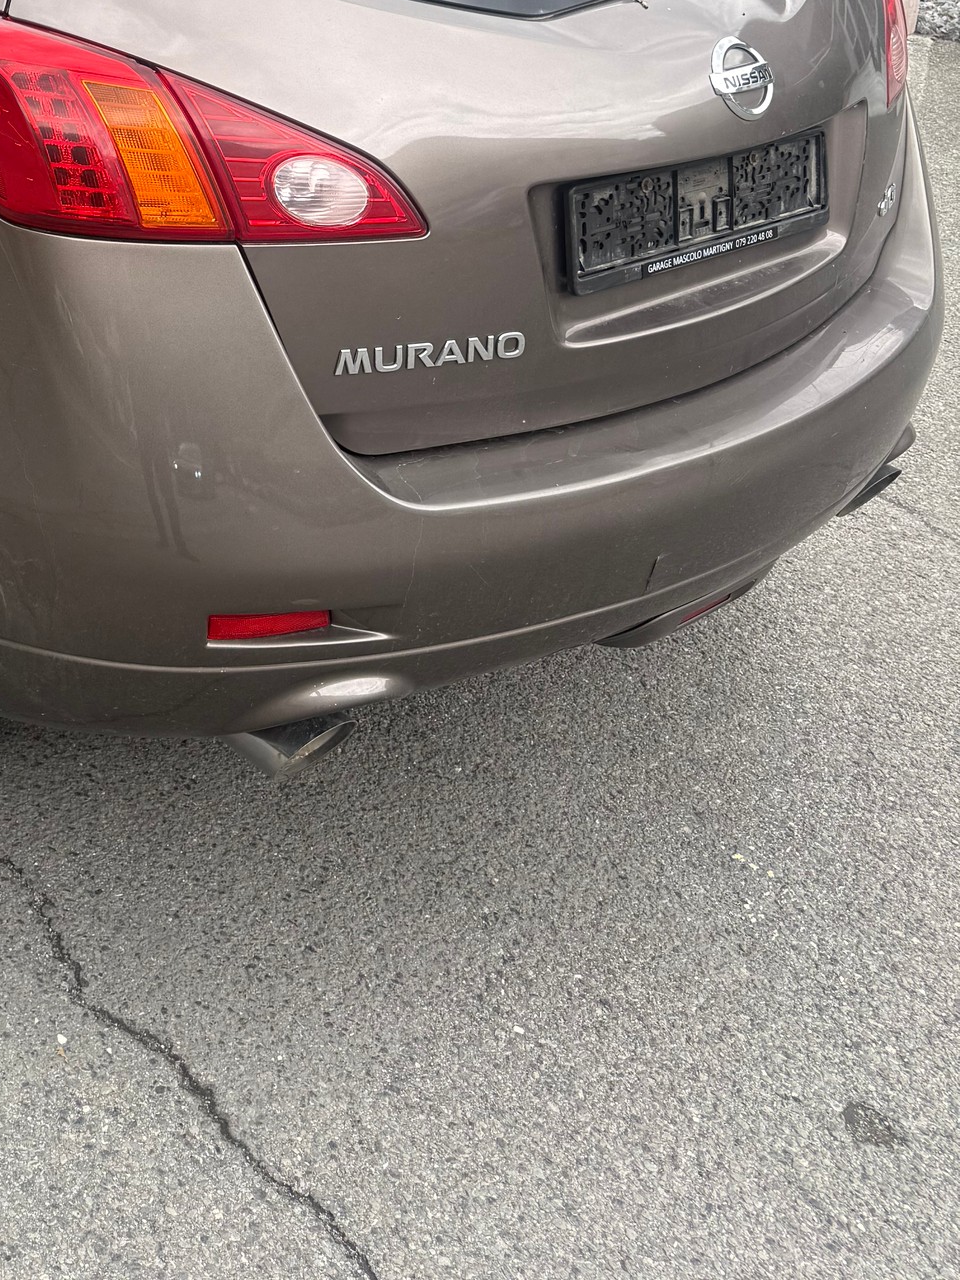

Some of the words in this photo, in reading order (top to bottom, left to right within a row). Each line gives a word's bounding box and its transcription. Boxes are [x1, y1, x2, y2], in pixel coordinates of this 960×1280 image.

[723, 68, 773, 90] NISSAN
[647, 259, 672, 273] GARAGE
[673, 250, 702, 266] MASCOLO
[703, 241, 734, 257] MARTIGNY
[735, 237, 747, 248] 079
[747, 234, 758, 245] 220
[334, 331, 526, 376] MURANO
